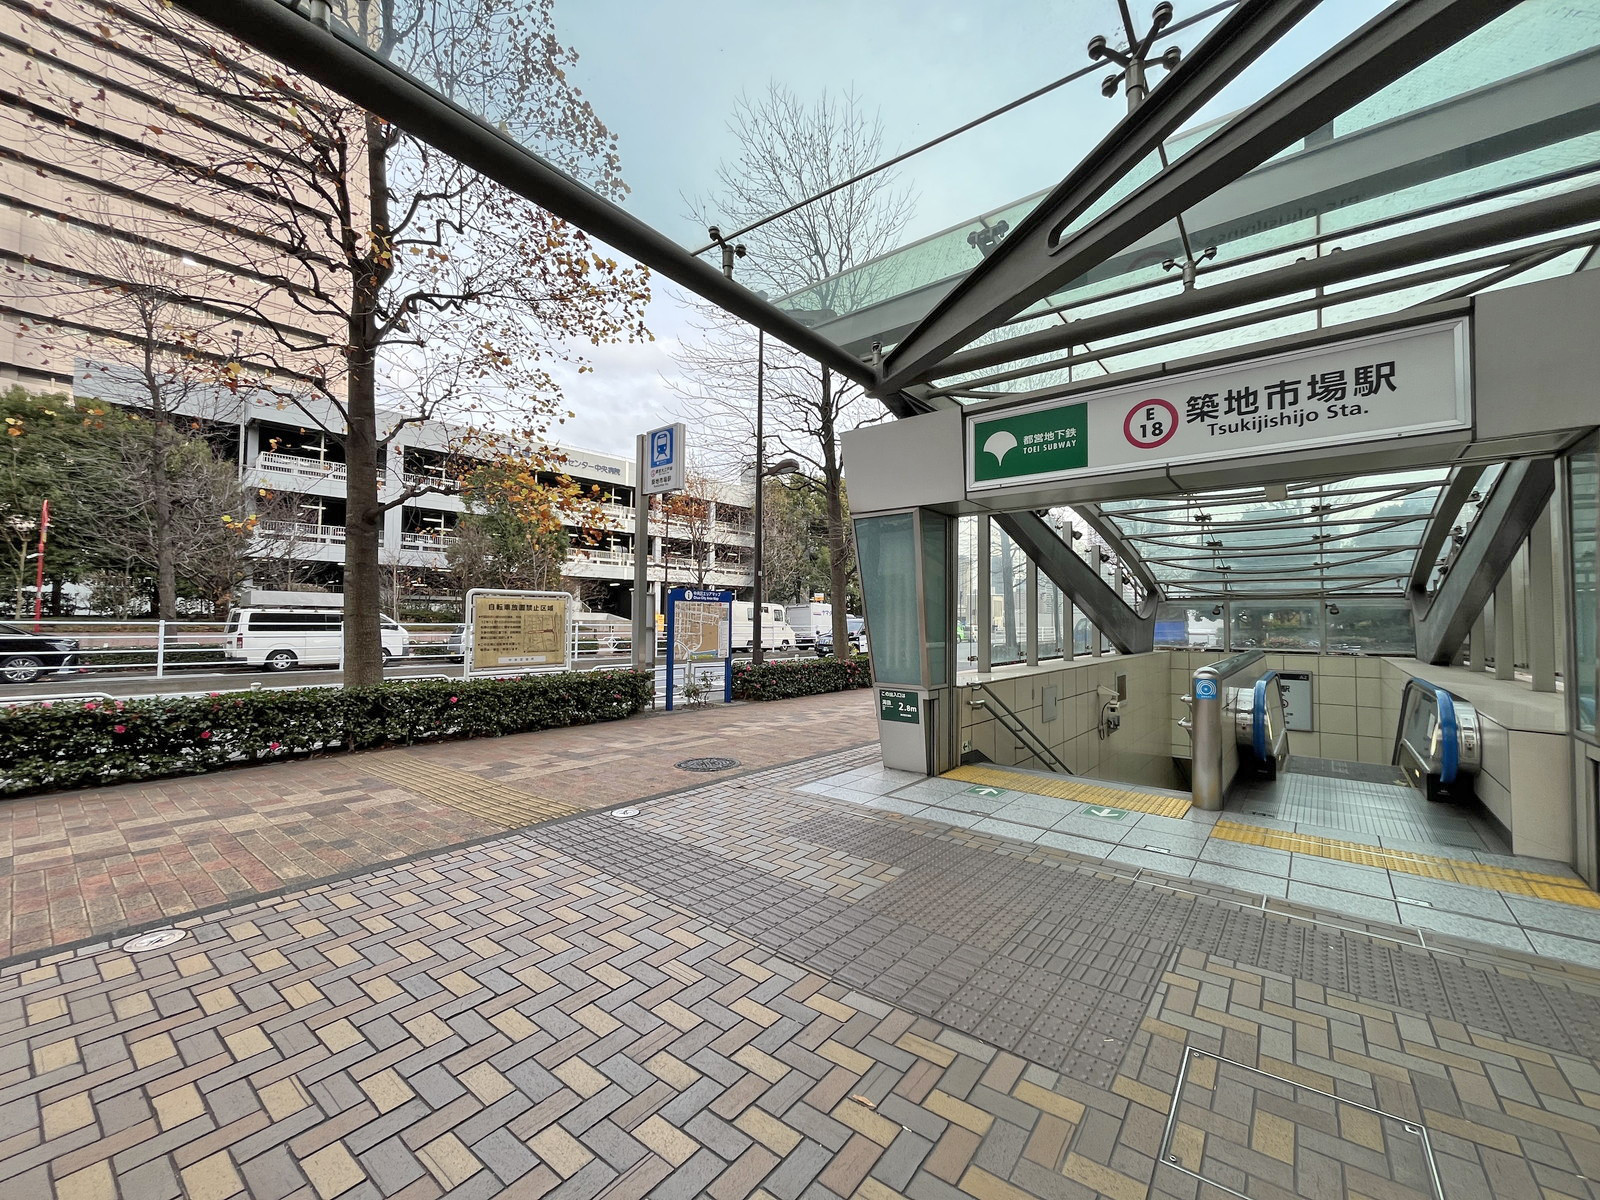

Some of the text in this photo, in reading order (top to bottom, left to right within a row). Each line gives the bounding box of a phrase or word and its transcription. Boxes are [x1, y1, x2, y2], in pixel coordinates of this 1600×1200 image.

[1186, 361, 1397, 424] 築地市場駅
[1146, 408, 1155, 421] E
[1207, 404, 1369, 436] Tsukijishijo Sta.
[1023, 428, 1077, 446] 都営地下鉄
[1140, 421, 1164, 438] 18
[1023, 440, 1077, 454] TOEI SUBWAY
[559, 459, 621, 476] センター中央病院
[898, 702, 917, 712] 2.8m
